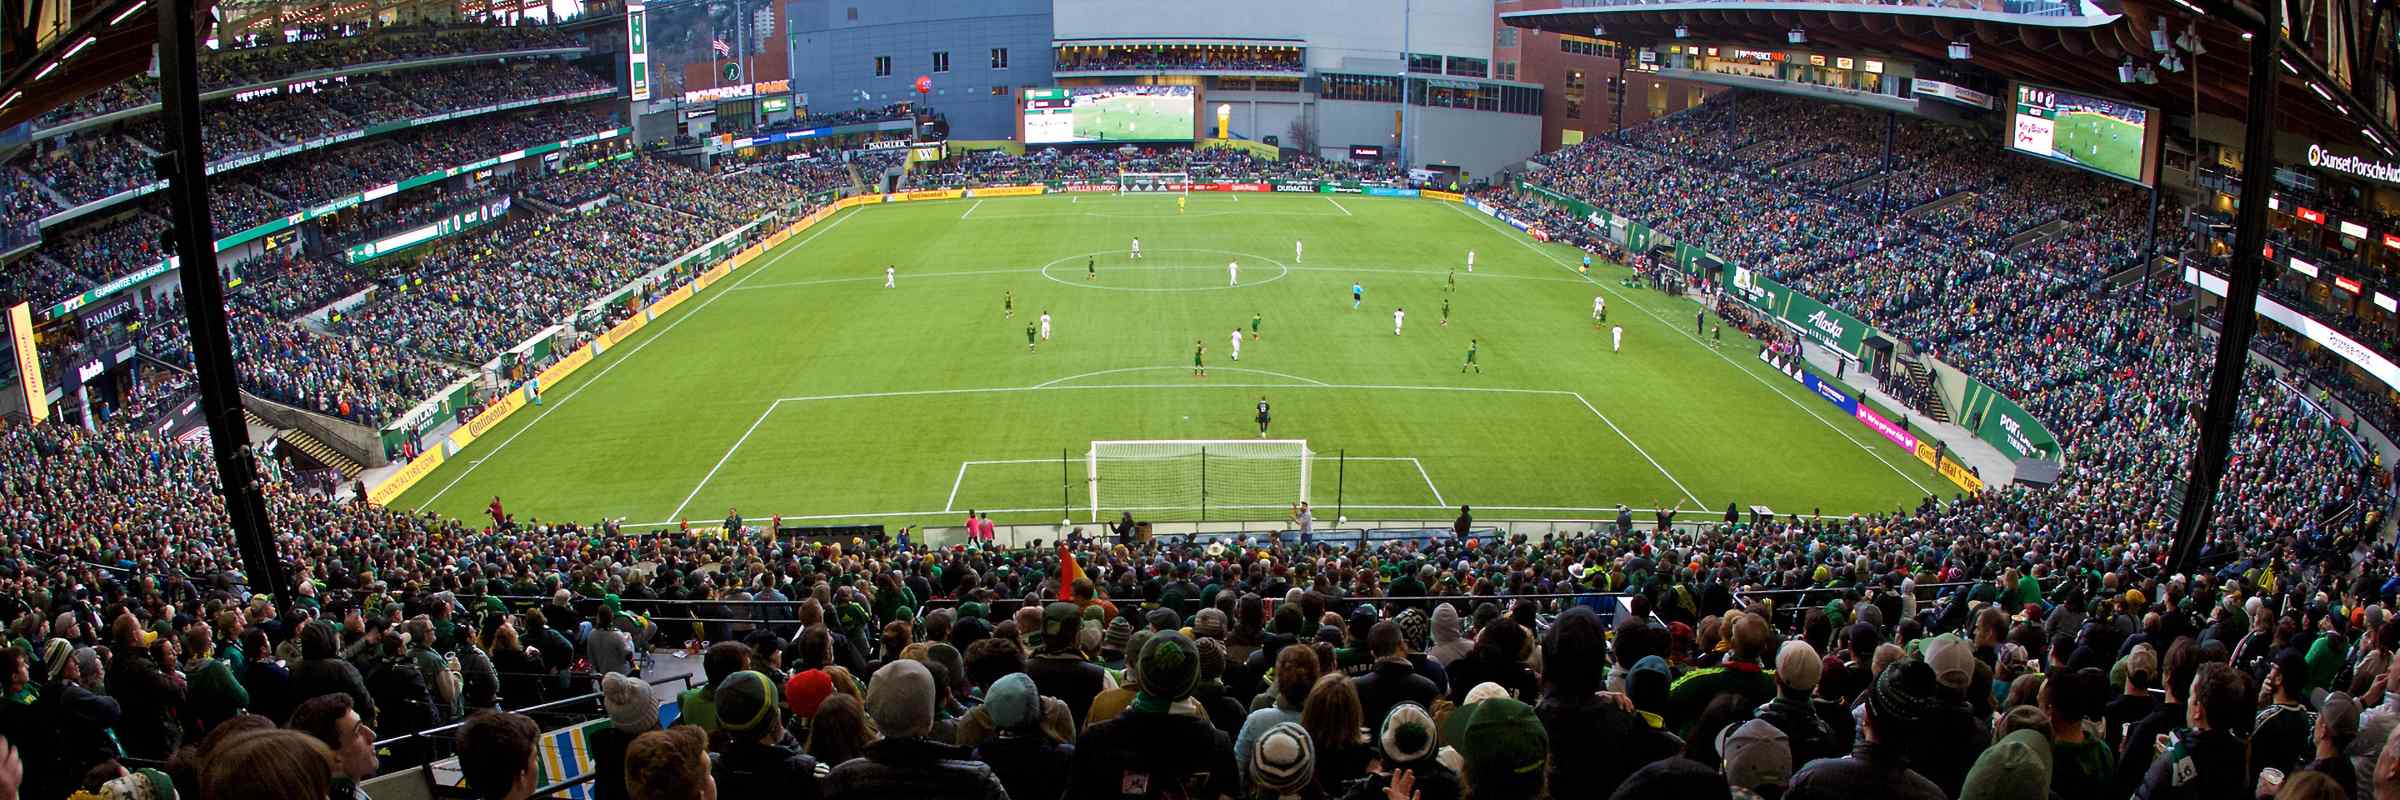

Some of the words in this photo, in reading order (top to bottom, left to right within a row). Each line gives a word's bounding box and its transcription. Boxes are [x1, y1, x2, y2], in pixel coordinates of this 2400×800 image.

[685, 84, 752, 103] PROVIDENCE
[755, 80, 790, 96] PARK
[2320, 149, 2351, 173] Sunset
[2351, 155, 2386, 181] Porsche
[1277, 184, 1313, 192] DURACELL
[95, 277, 131, 298] GUARANTEE
[131, 270, 147, 283] YOUR
[1808, 310, 1843, 339] Alaska
[469, 402, 507, 438] Continental
